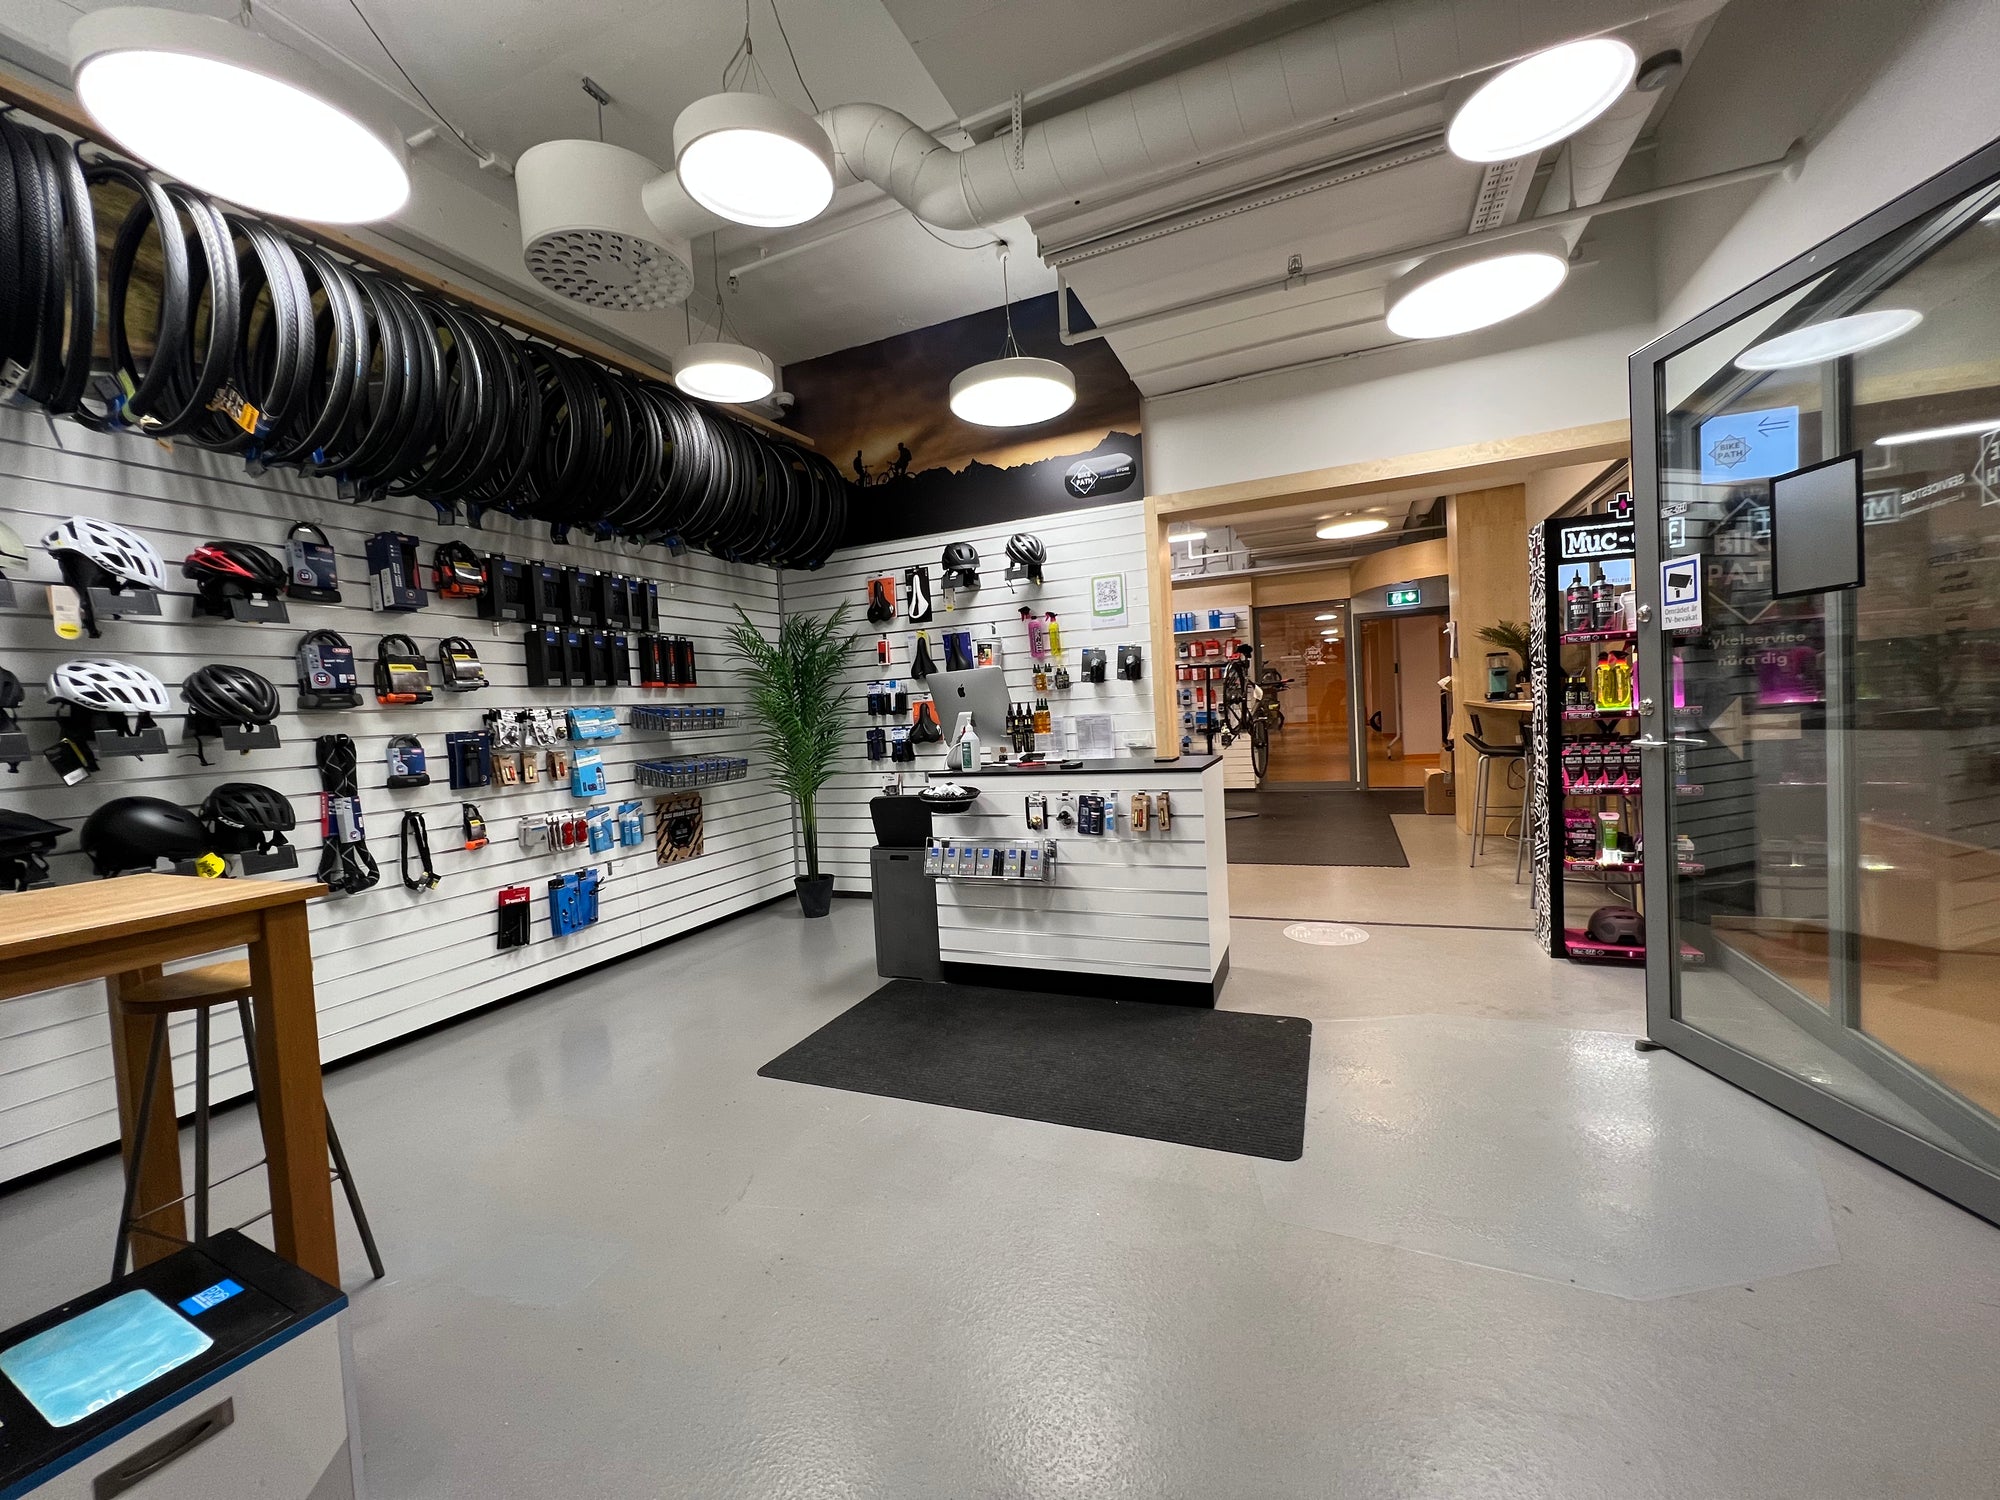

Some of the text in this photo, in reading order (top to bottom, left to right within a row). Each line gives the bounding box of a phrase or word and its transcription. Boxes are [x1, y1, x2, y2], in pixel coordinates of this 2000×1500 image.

[1720, 441, 1740, 451] BIKE
[1717, 450, 1743, 459] PATH
[1076, 478, 1093, 486] PATH
[1567, 531, 1635, 554] Muc-
[1714, 530, 1771, 556] BIK
[1708, 560, 1771, 586] PAT
[1664, 606, 1690, 616] Området
[1665, 613, 1698, 623] TV-bevakat
[1708, 632, 1806, 650] ykelservice
[1718, 652, 1788, 667] nära dig
